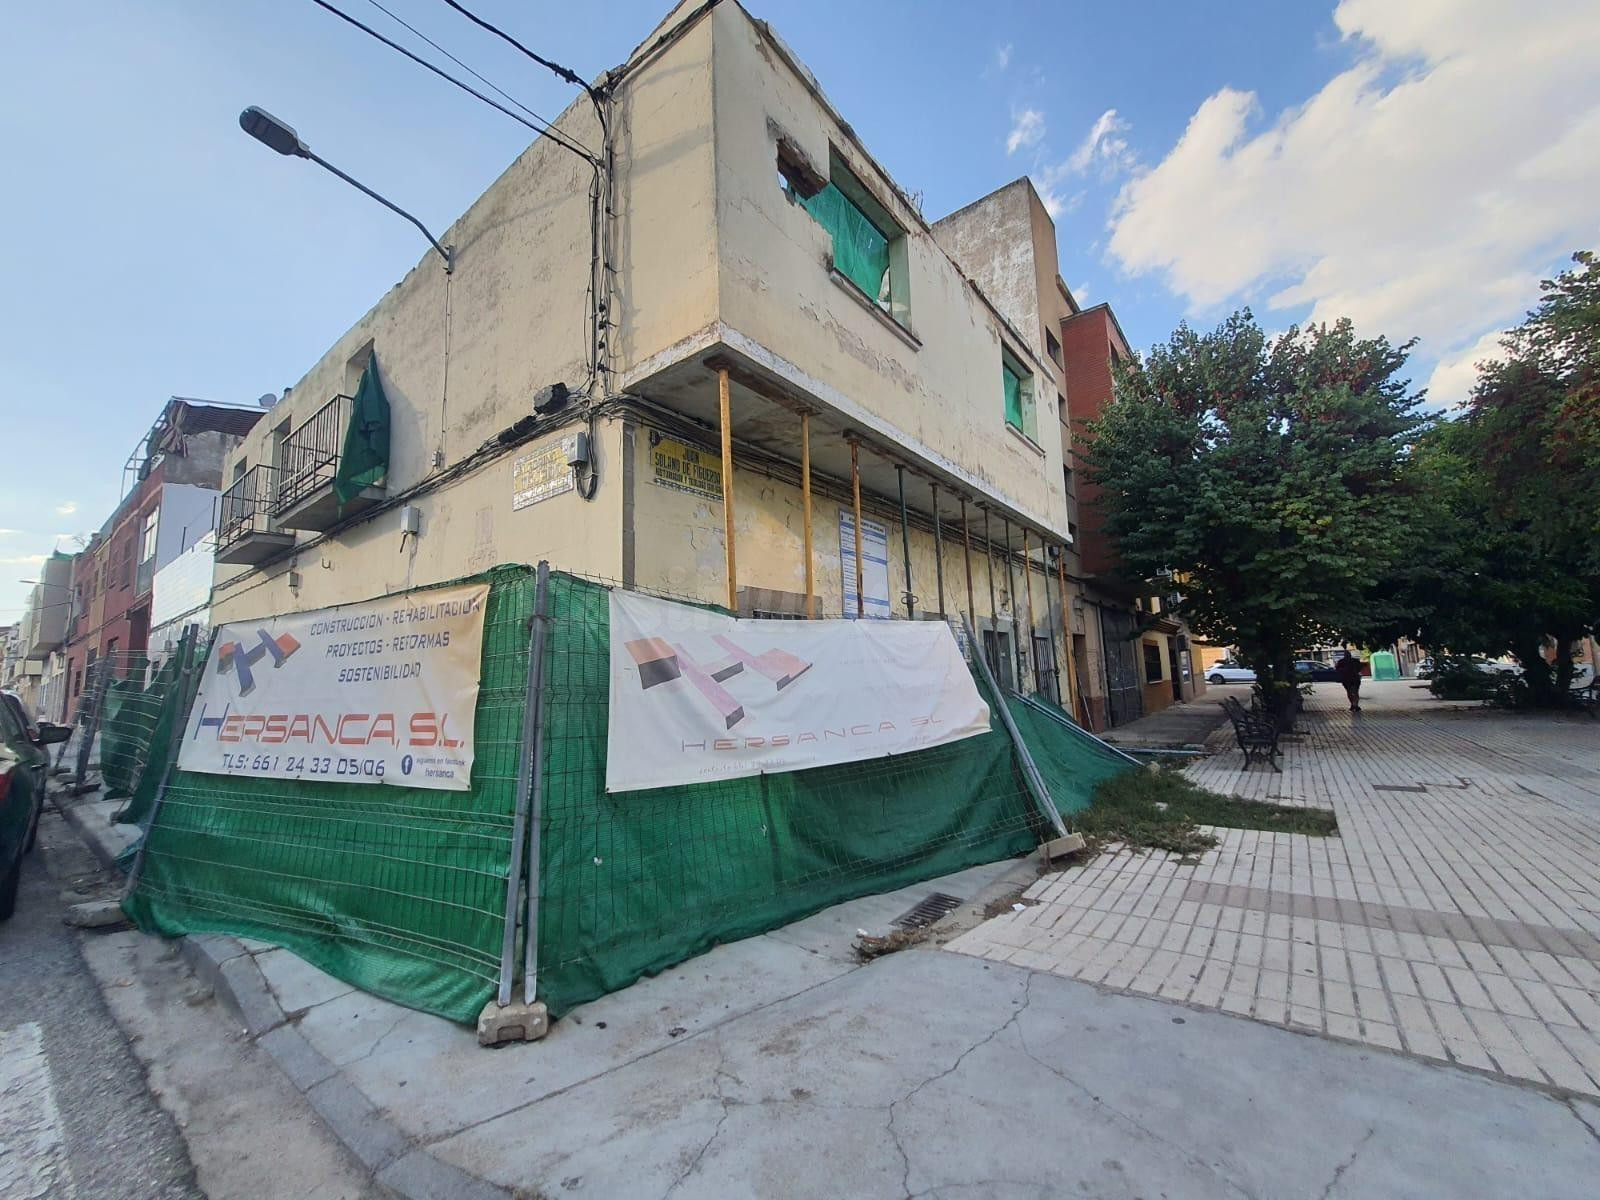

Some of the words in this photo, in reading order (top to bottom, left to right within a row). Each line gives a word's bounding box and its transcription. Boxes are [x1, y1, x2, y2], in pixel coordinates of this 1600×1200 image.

[326, 639, 383, 658] PROYECTOS
[392, 631, 450, 652] REFORMAS
[338, 661, 422, 683] SOSTENIBILIDAD
[682, 721, 896, 752] HERSANCA
[286, 757, 305, 772] 24
[309, 757, 331, 773] 33
